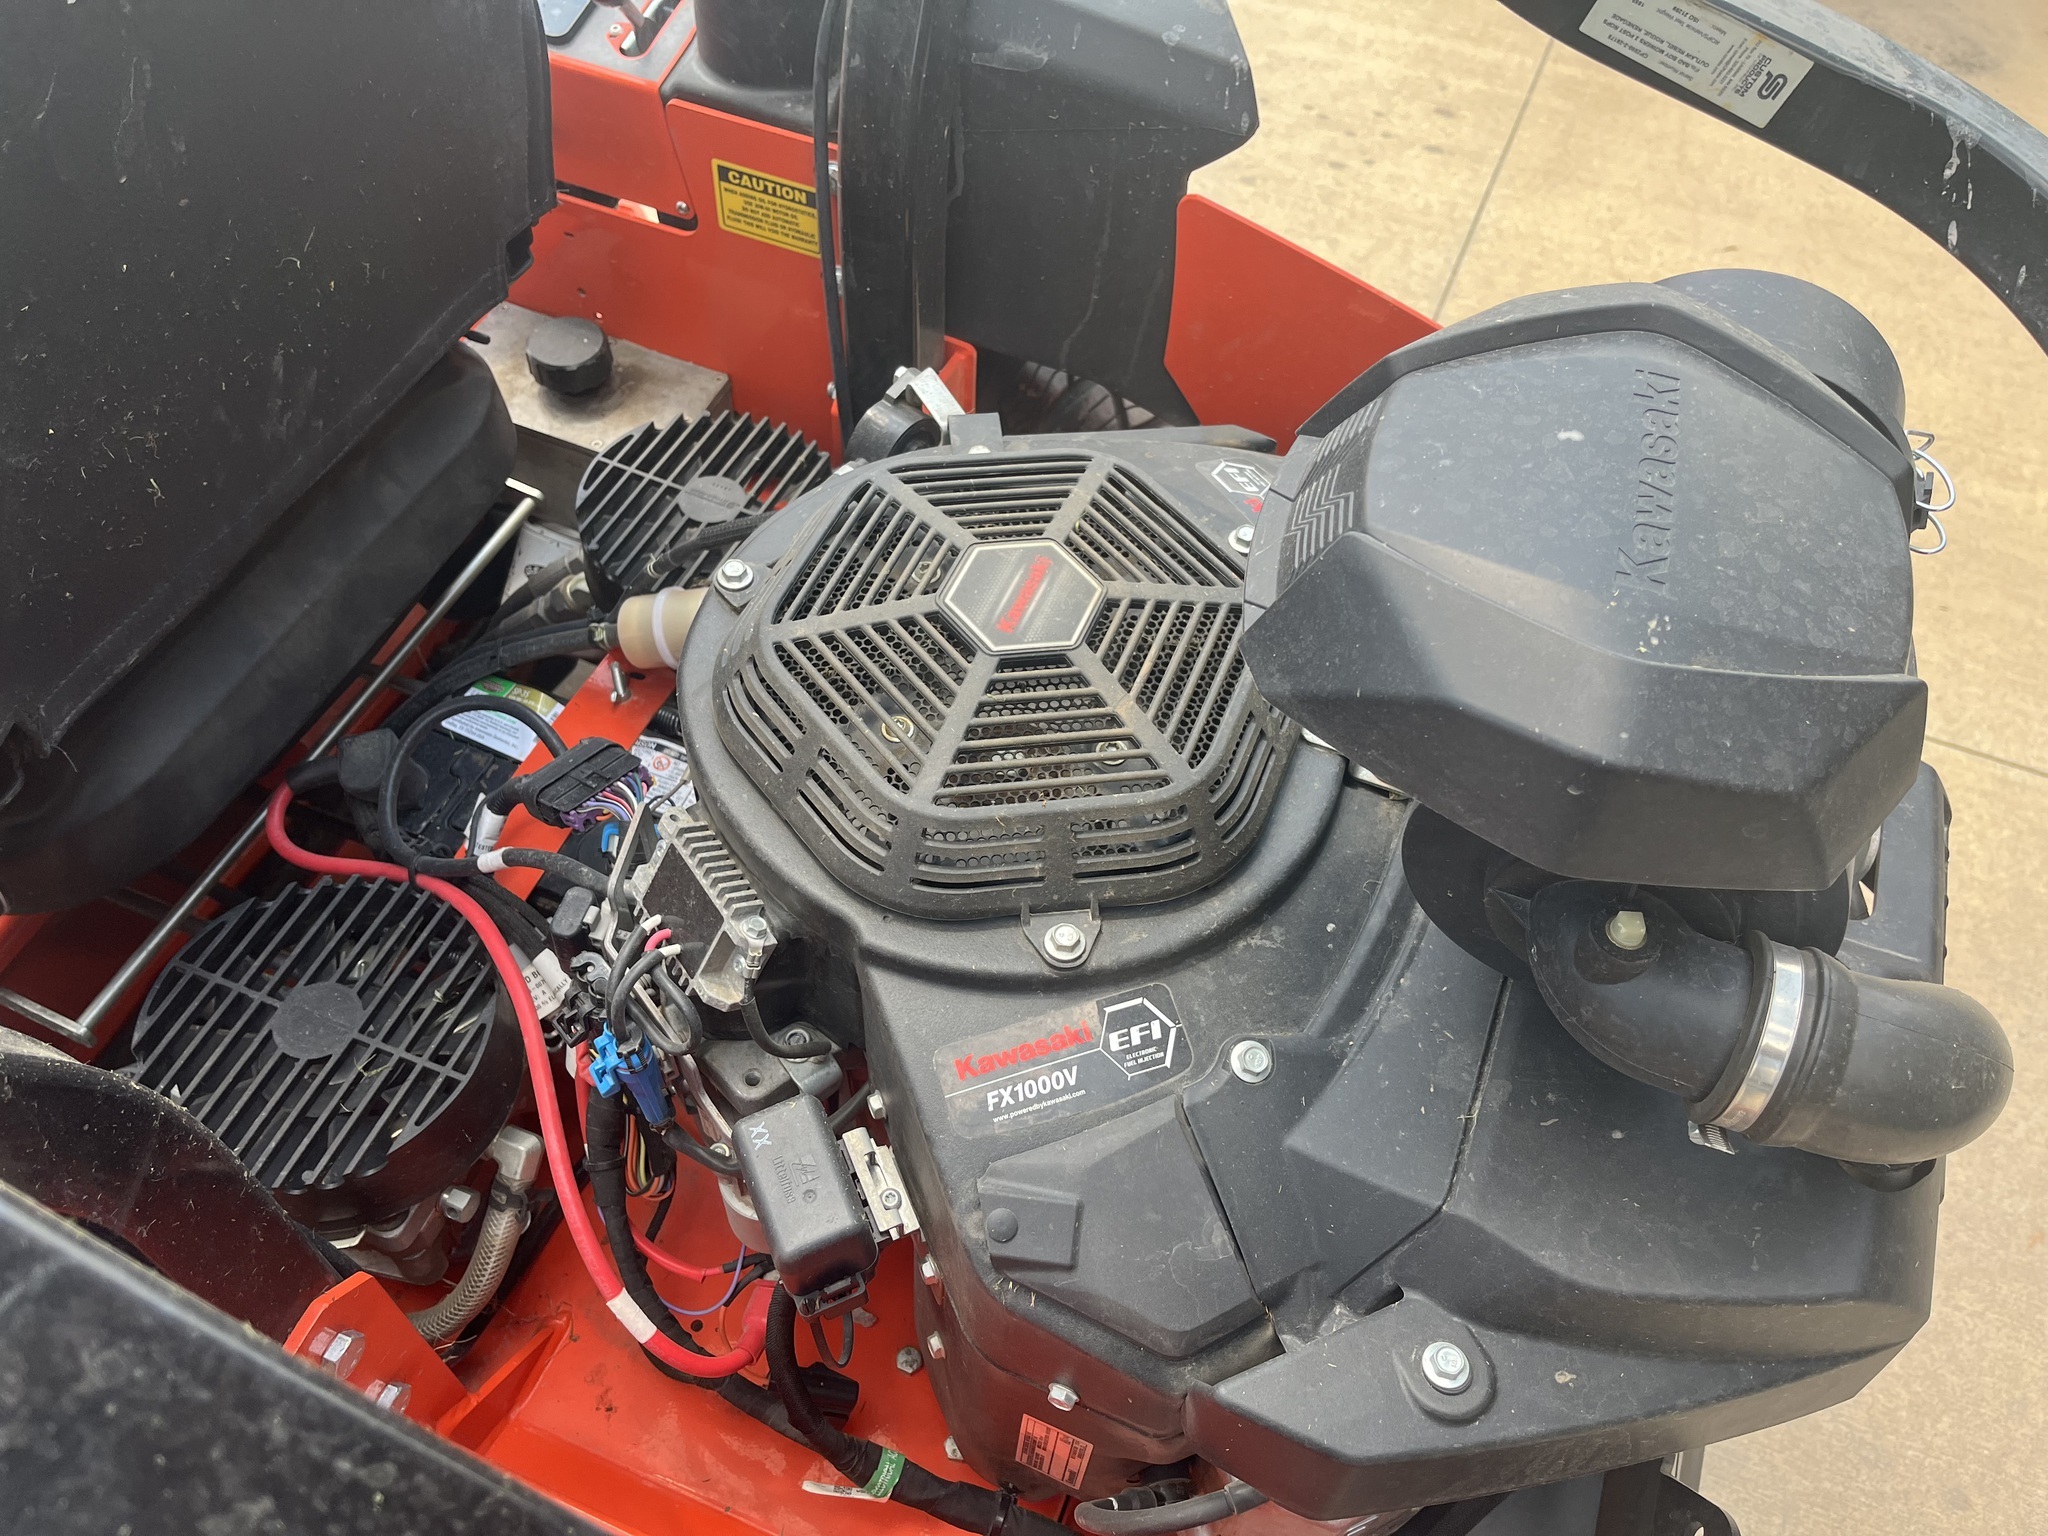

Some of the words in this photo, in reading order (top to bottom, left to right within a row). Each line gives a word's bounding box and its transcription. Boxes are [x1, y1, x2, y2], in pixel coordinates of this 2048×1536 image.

[1612, 14, 1642, 32] RENEGADE
[1664, 52, 1678, 62] BOY
[1684, 52, 1710, 68] OUTLAW
[1734, 54, 1766, 94] PRODUCTS
[1740, 58, 1772, 97] CUSTOM
[728, 170, 807, 204] CAUTION
[1224, 468, 1260, 492] EFI
[1614, 368, 1680, 592] Kawasaki
[996, 554, 1053, 634] Kawasaki
[954, 1020, 1094, 1082] Kawasaki
[1108, 1018, 1162, 1052] EFI
[1124, 1058, 1137, 1068] FUEL
[1137, 1052, 1164, 1066] INJECTION
[986, 1065, 1078, 1112] FX1000V
[992, 1088, 1086, 1123] www.poweredbykawasaki.com
